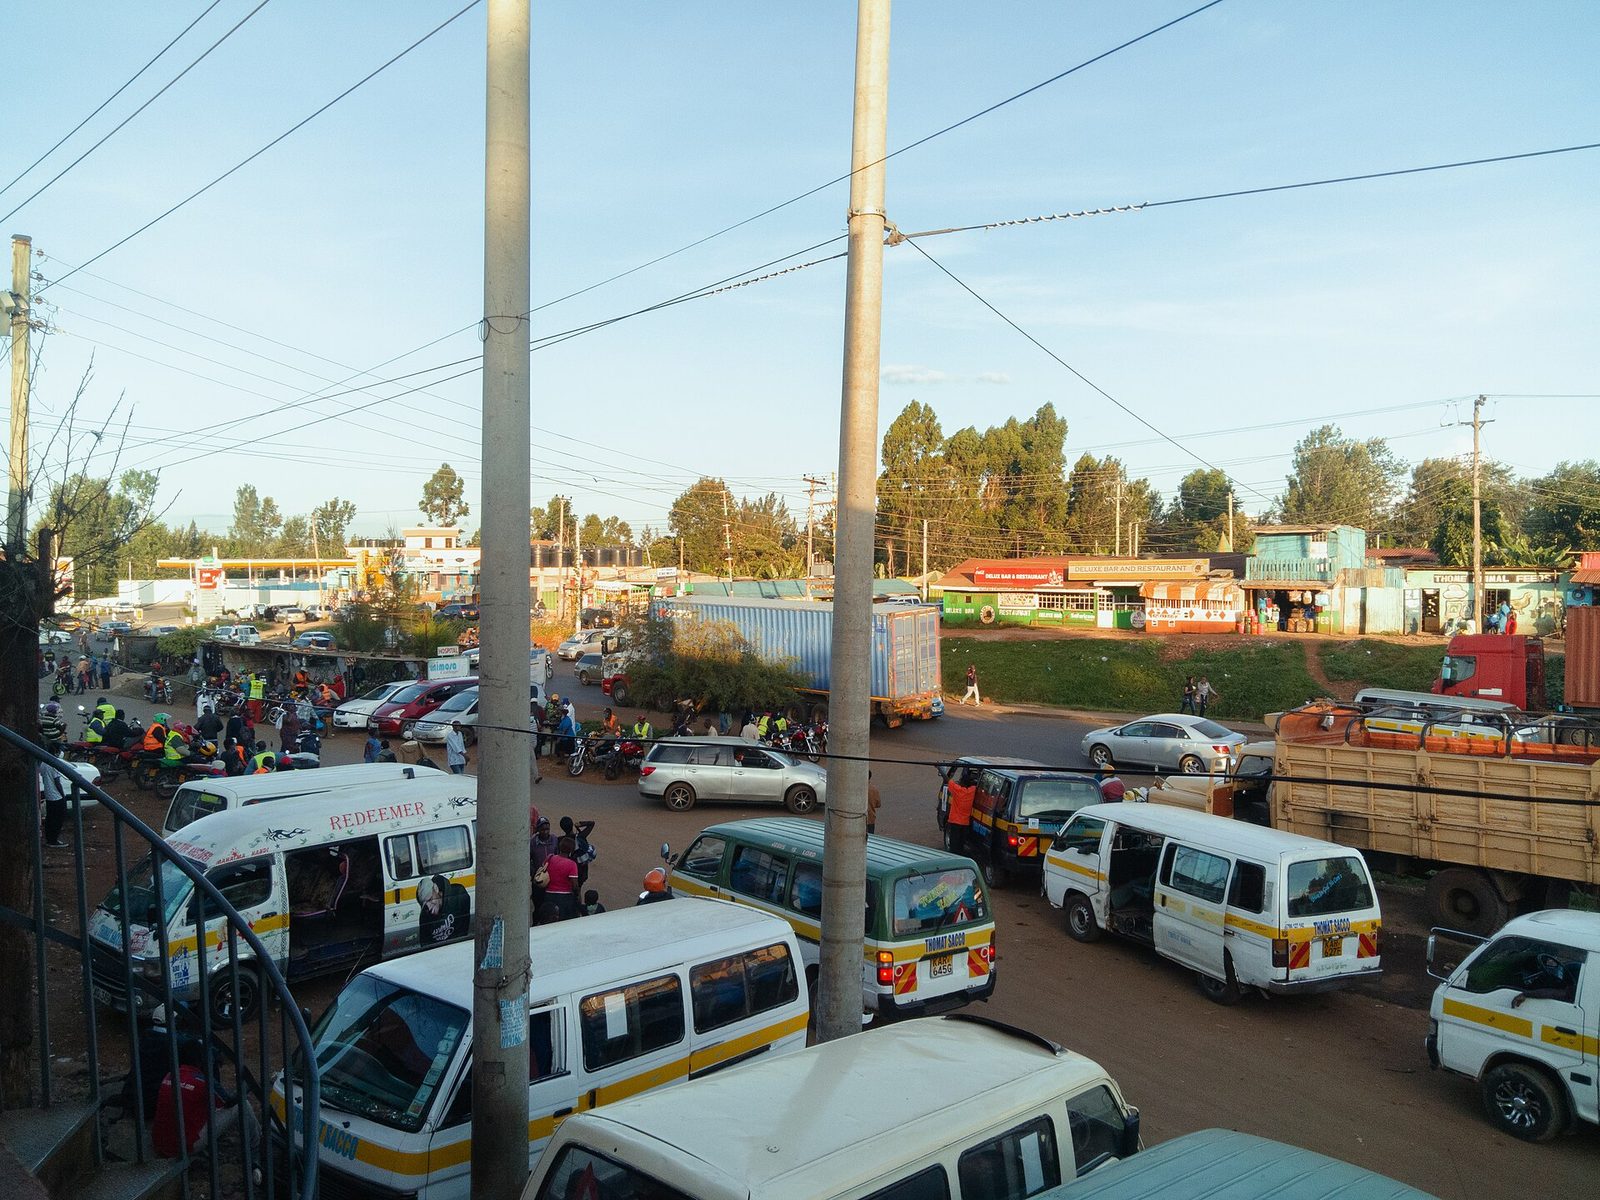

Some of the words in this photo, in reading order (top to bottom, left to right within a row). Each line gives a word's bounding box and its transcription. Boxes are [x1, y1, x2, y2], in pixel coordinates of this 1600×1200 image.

[1434, 574, 1468, 583] THOME
[1515, 574, 1552, 583] FEEDS
[329, 801, 426, 830] REDEEMER
[1313, 919, 1333, 936] THOMAT
[1333, 917, 1351, 933] SACCO
[925, 935, 947, 953] THOMAT
[948, 931, 966, 948] SACCO
[932, 963, 952, 976] 645G
